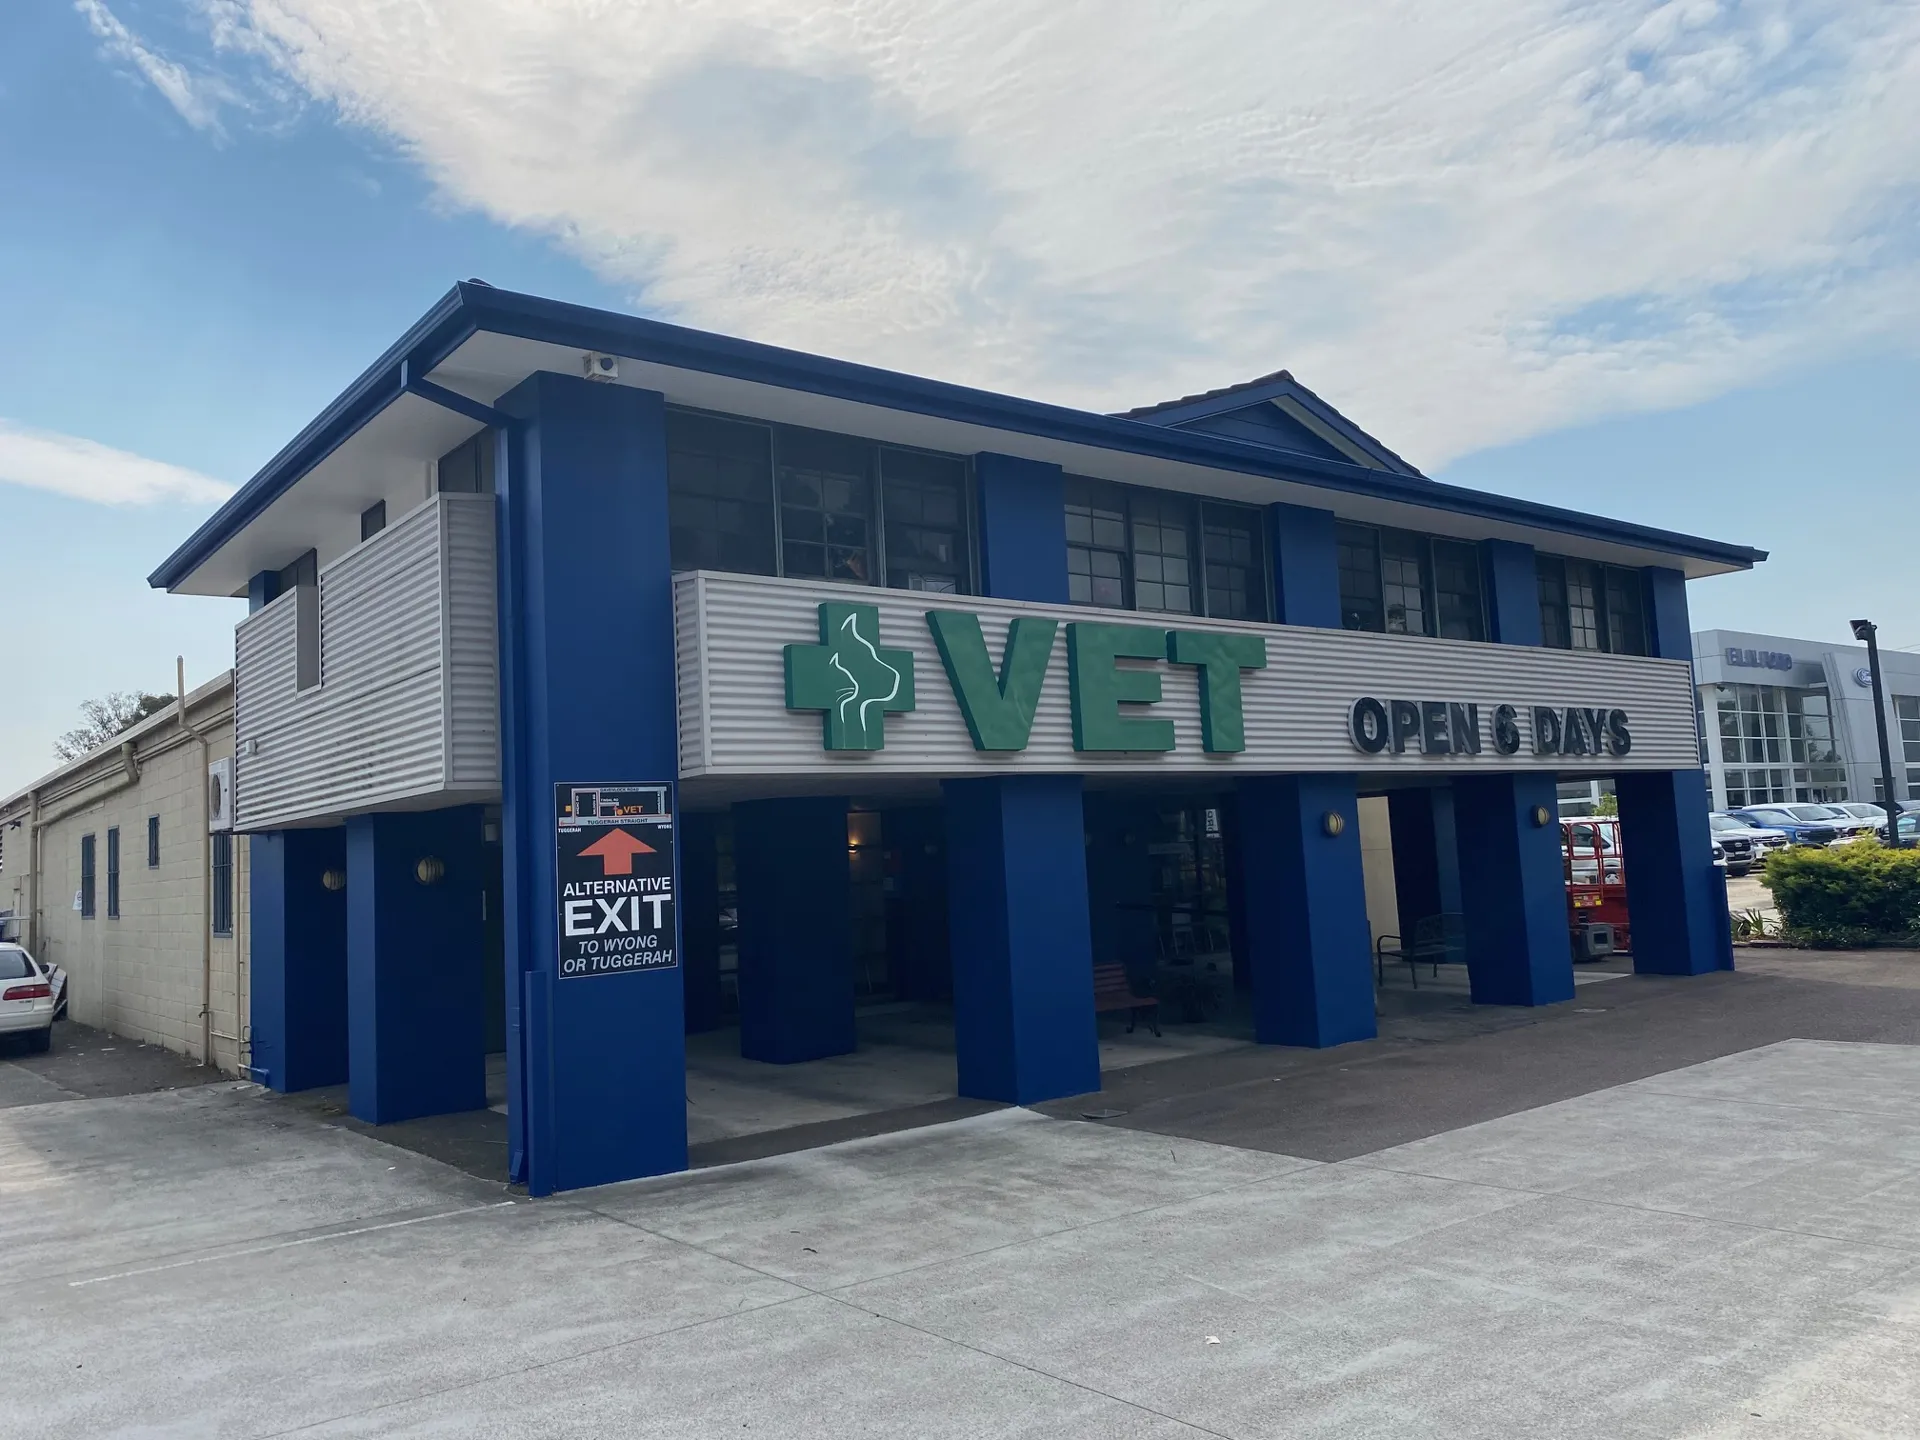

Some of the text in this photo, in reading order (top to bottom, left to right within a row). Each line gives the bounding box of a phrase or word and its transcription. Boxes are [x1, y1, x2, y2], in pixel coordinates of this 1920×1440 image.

[925, 610, 1267, 753] VET
[1347, 696, 1632, 757] OPEN 6 DAYS
[624, 806, 644, 814] VET
[563, 876, 672, 897] ALTERNATIVE
[564, 893, 672, 937] EXIT
[578, 934, 658, 955] TO WYONG
[563, 949, 673, 973] OR TUGGERAH
